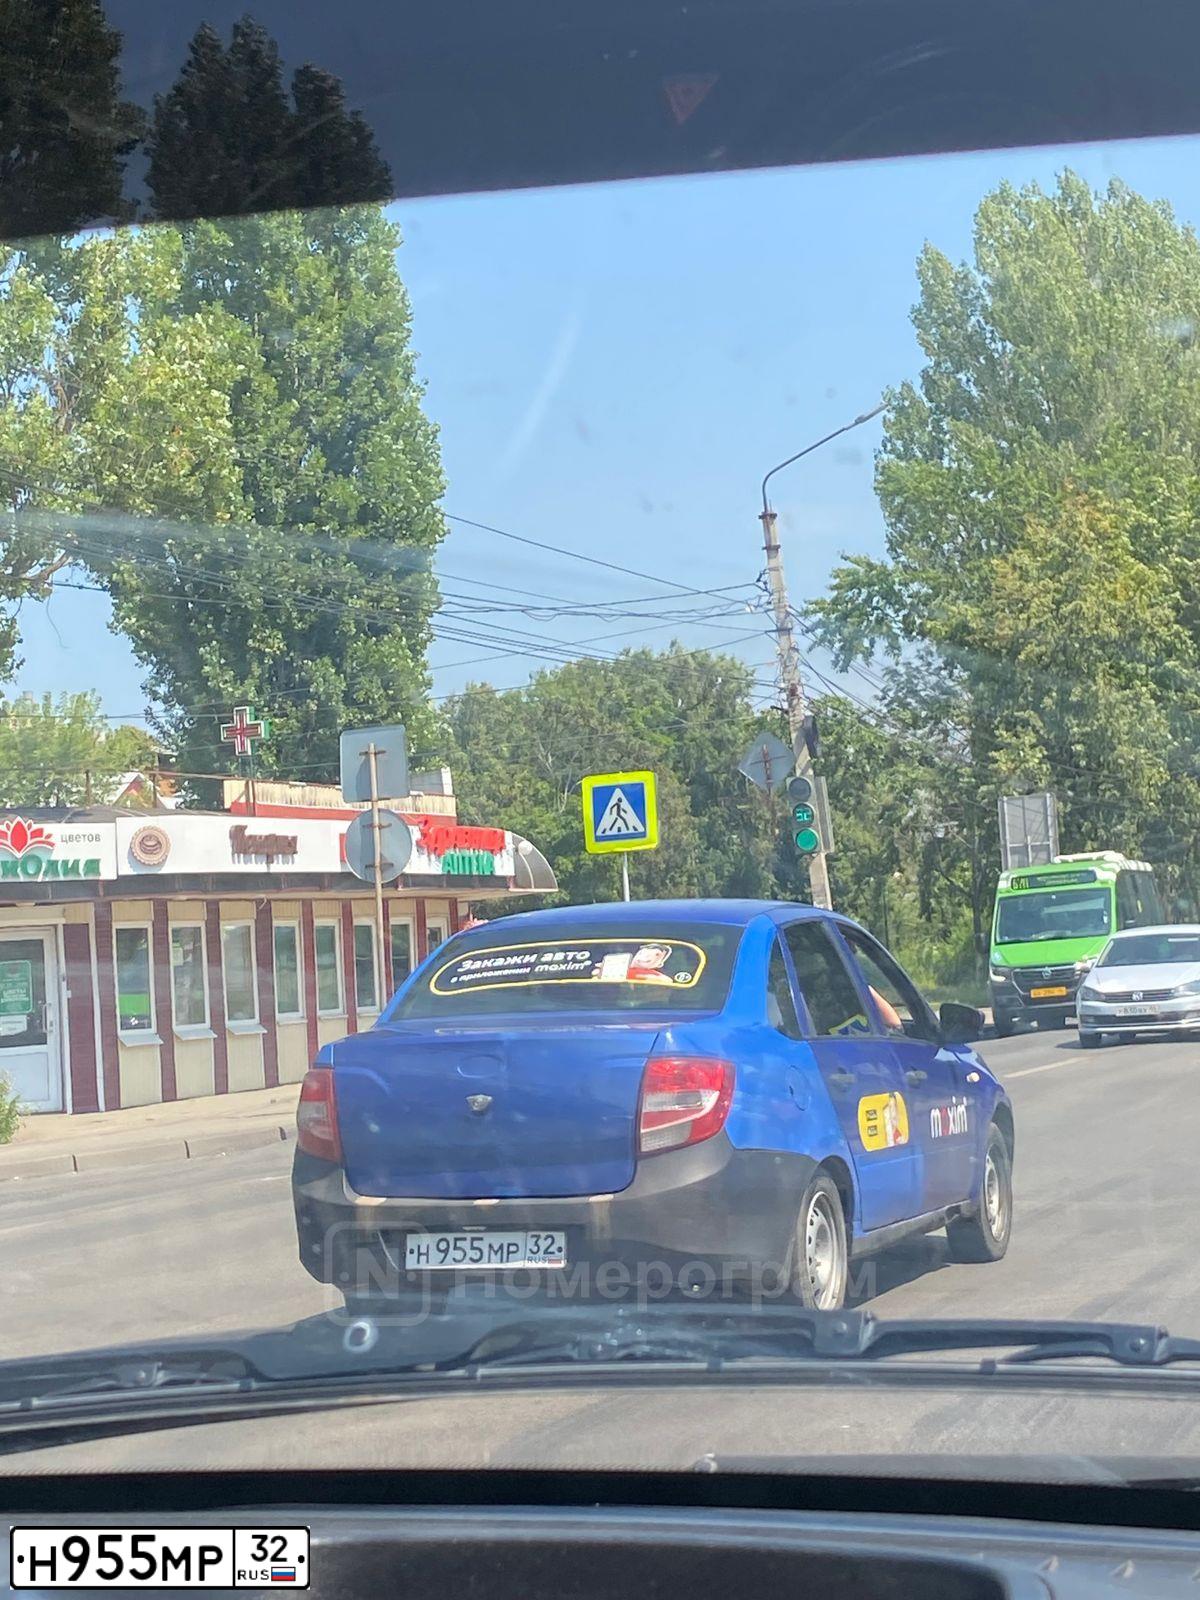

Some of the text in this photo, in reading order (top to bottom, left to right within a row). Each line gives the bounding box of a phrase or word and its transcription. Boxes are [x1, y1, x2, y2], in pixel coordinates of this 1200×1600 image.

[61, 833, 101, 844] цветов
[457, 950, 591, 972] Закажи авто
[528, 1234, 556, 1256] 32
[527, 1255, 549, 1264] RUS
